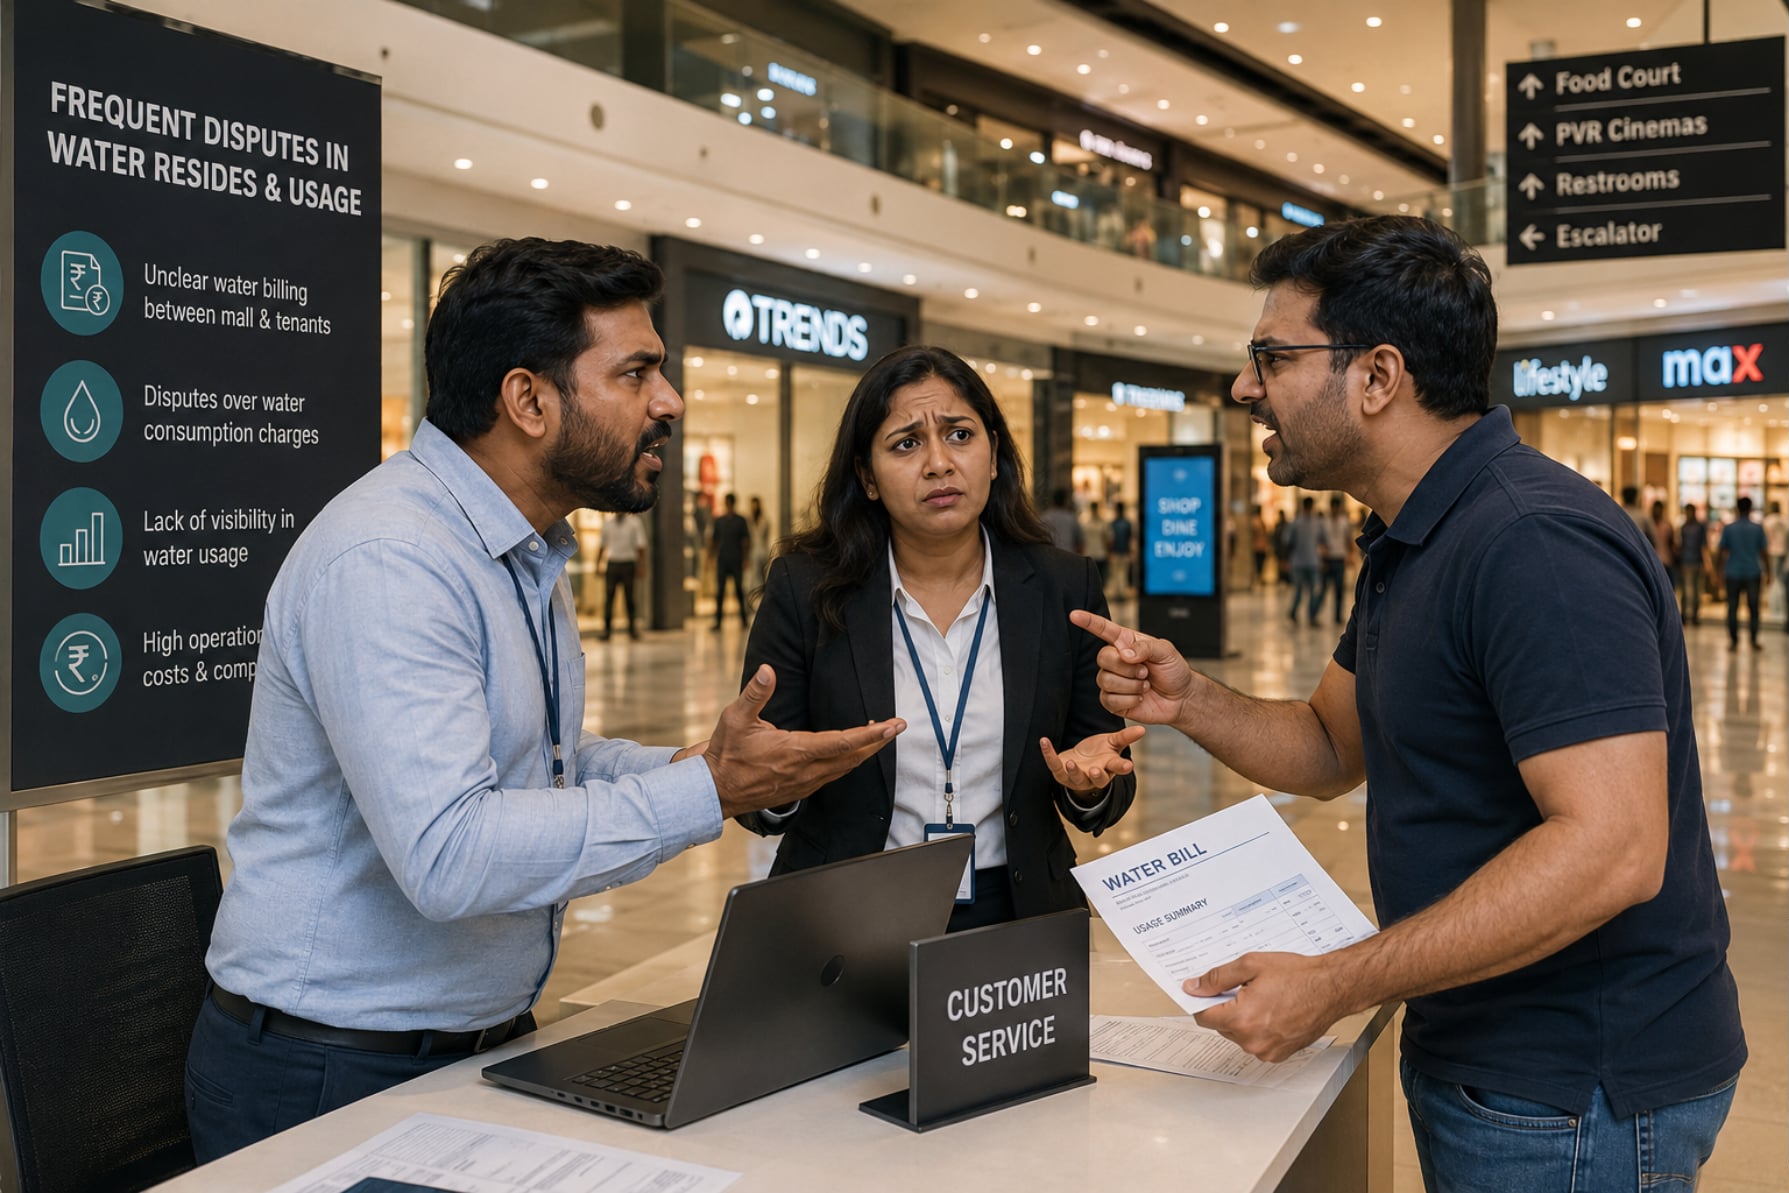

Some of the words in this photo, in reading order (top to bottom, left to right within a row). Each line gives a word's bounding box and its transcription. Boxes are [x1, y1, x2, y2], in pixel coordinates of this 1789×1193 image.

[1556, 68, 1612, 94] Food
[1617, 63, 1681, 88] Court
[51, 80, 196, 140] FREQUENT
[204, 116, 319, 165] DISPUTES
[326, 142, 349, 171] IN
[1556, 121, 1603, 145] PVR
[1607, 116, 1708, 141] Cinemas
[47, 131, 146, 178] WATER
[154, 152, 257, 197] RESIDES
[264, 173, 282, 201] &
[289, 177, 362, 215] USAGE
[1556, 170, 1680, 195] Restrooms
[1556, 222, 1662, 248] Escalator
[144, 263, 209, 290] Unclear
[213, 276, 259, 296] water
[263, 277, 308, 306] billing
[144, 296, 216, 324] between
[221, 307, 254, 327] mall
[259, 309, 271, 329] &
[275, 312, 331, 334] tenants
[752, 295, 869, 360] TRENDS
[1513, 356, 1608, 400] lifestyle
[1662, 344, 1763, 387] max
[144, 385, 218, 412] Disputes
[222, 394, 258, 410] over
[261, 394, 306, 412] water
[143, 422, 254, 446] consumption
[258, 423, 319, 448] charges
[144, 510, 185, 531] Lack
[189, 509, 207, 530] of
[210, 509, 277, 533] visibility
[281, 508, 295, 528] in
[1157, 498, 1202, 514] SHOP
[1161, 520, 1198, 535] DINE
[143, 546, 194, 566] water
[199, 544, 249, 568] usage
[1154, 541, 1205, 557] ENJOY
[143, 630, 183, 656] High
[142, 665, 190, 686] costs
[195, 661, 208, 681] &
[1101, 859, 1167, 890] WATER
[1166, 844, 1208, 866] BILL
[1132, 917, 1165, 934] USAGE
[1163, 898, 1208, 922] SUMMARY
[948, 967, 1067, 1022] CUSTOMER
[961, 1016, 1056, 1065] SERVICE
